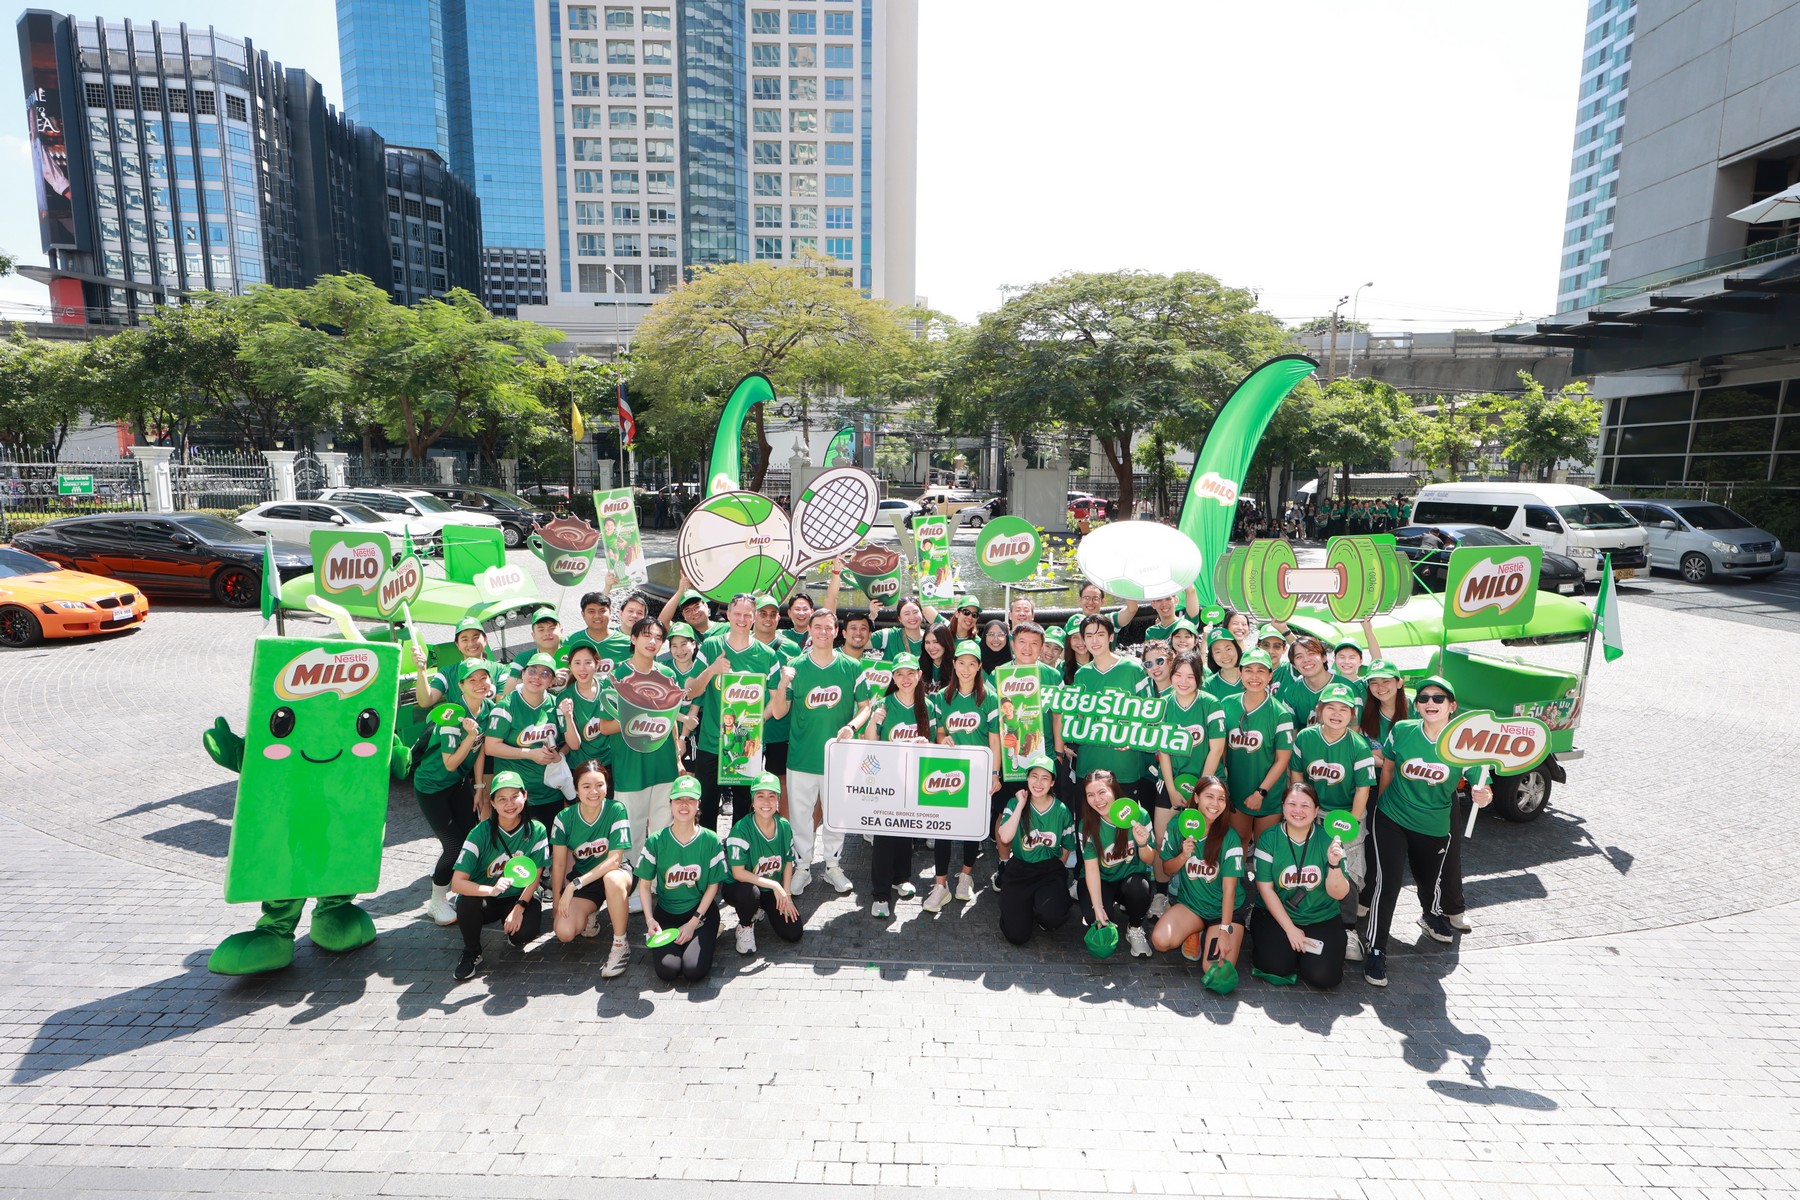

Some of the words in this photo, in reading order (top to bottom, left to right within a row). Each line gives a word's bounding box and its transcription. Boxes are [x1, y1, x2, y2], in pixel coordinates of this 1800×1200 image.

[1201, 479, 1235, 501] MILO
[603, 501, 629, 514] MILO
[919, 527, 943, 536] MILO
[749, 537, 771, 545] MILO
[989, 541, 1030, 559] MILO
[330, 557, 379, 581] MILO
[555, 560, 586, 571] MILO
[382, 569, 417, 605] MILO
[489, 572, 521, 589] MILO
[871, 582, 897, 594] MILO
[1463, 572, 1524, 603] MILO
[290, 662, 370, 687] MILO
[865, 671, 890, 684] MILO
[1003, 681, 1035, 692] MILO
[728, 688, 760, 700] MILO
[810, 691, 838, 704] MILO
[631, 720, 667, 734] MILO
[949, 718, 977, 728] MILO
[1062, 714, 1189, 752] ไปกับไมโล
[1230, 734, 1259, 746] MILO
[1455, 727, 1536, 757] MILO
[1311, 765, 1341, 780] MILO
[1405, 763, 1445, 781] MILO
[928, 777, 961, 789] MILO
[846, 785, 896, 796] THAILAND
[861, 816, 882, 827] SEA
[885, 817, 923, 829] GAMES
[926, 820, 952, 831] 2025
[1334, 822, 1350, 830] MILO
[578, 844, 607, 857] MILO
[1187, 863, 1217, 876] MILO
[667, 870, 698, 884] MILO
